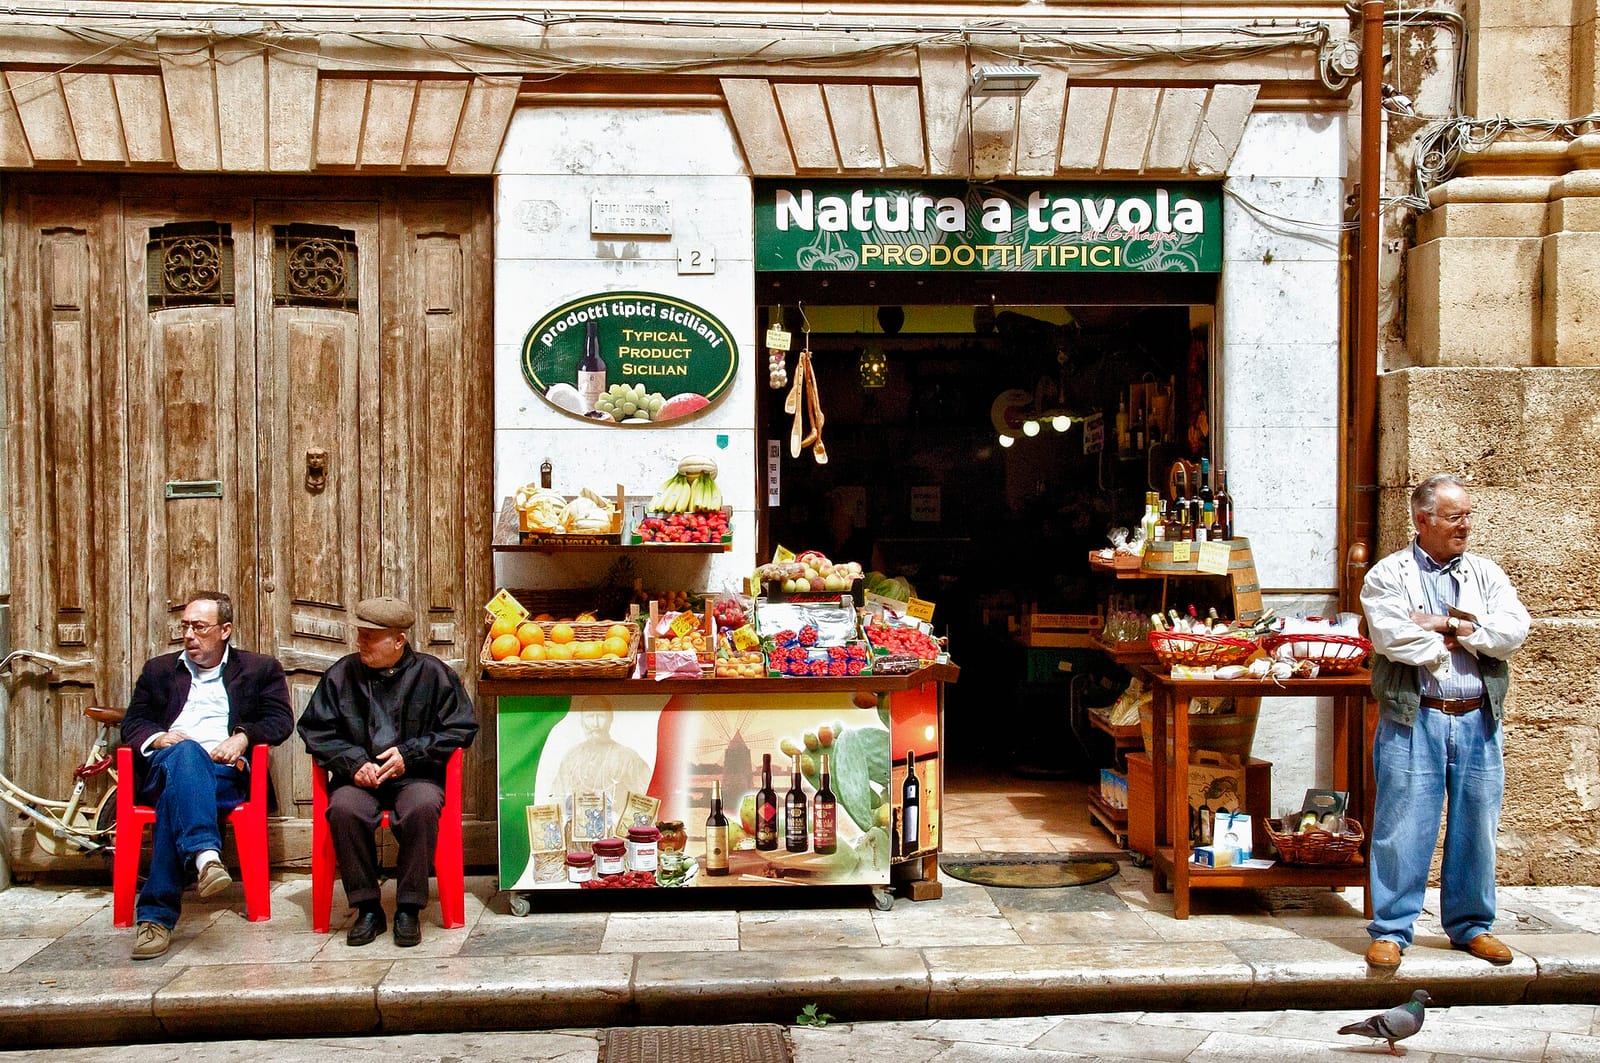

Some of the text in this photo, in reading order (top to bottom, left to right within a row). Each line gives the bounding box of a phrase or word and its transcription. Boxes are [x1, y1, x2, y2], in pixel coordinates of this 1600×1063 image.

[775, 188, 1204, 235] Natura a tavola
[690, 250, 702, 267] 2
[860, 244, 1121, 267] PRODOTTI TIPICI
[540, 301, 724, 349] prodotti tipici siciliani
[622, 329, 688, 342] TYPICAL
[618, 346, 692, 359] PRODUCT
[622, 363, 687, 376] SICILIAN
